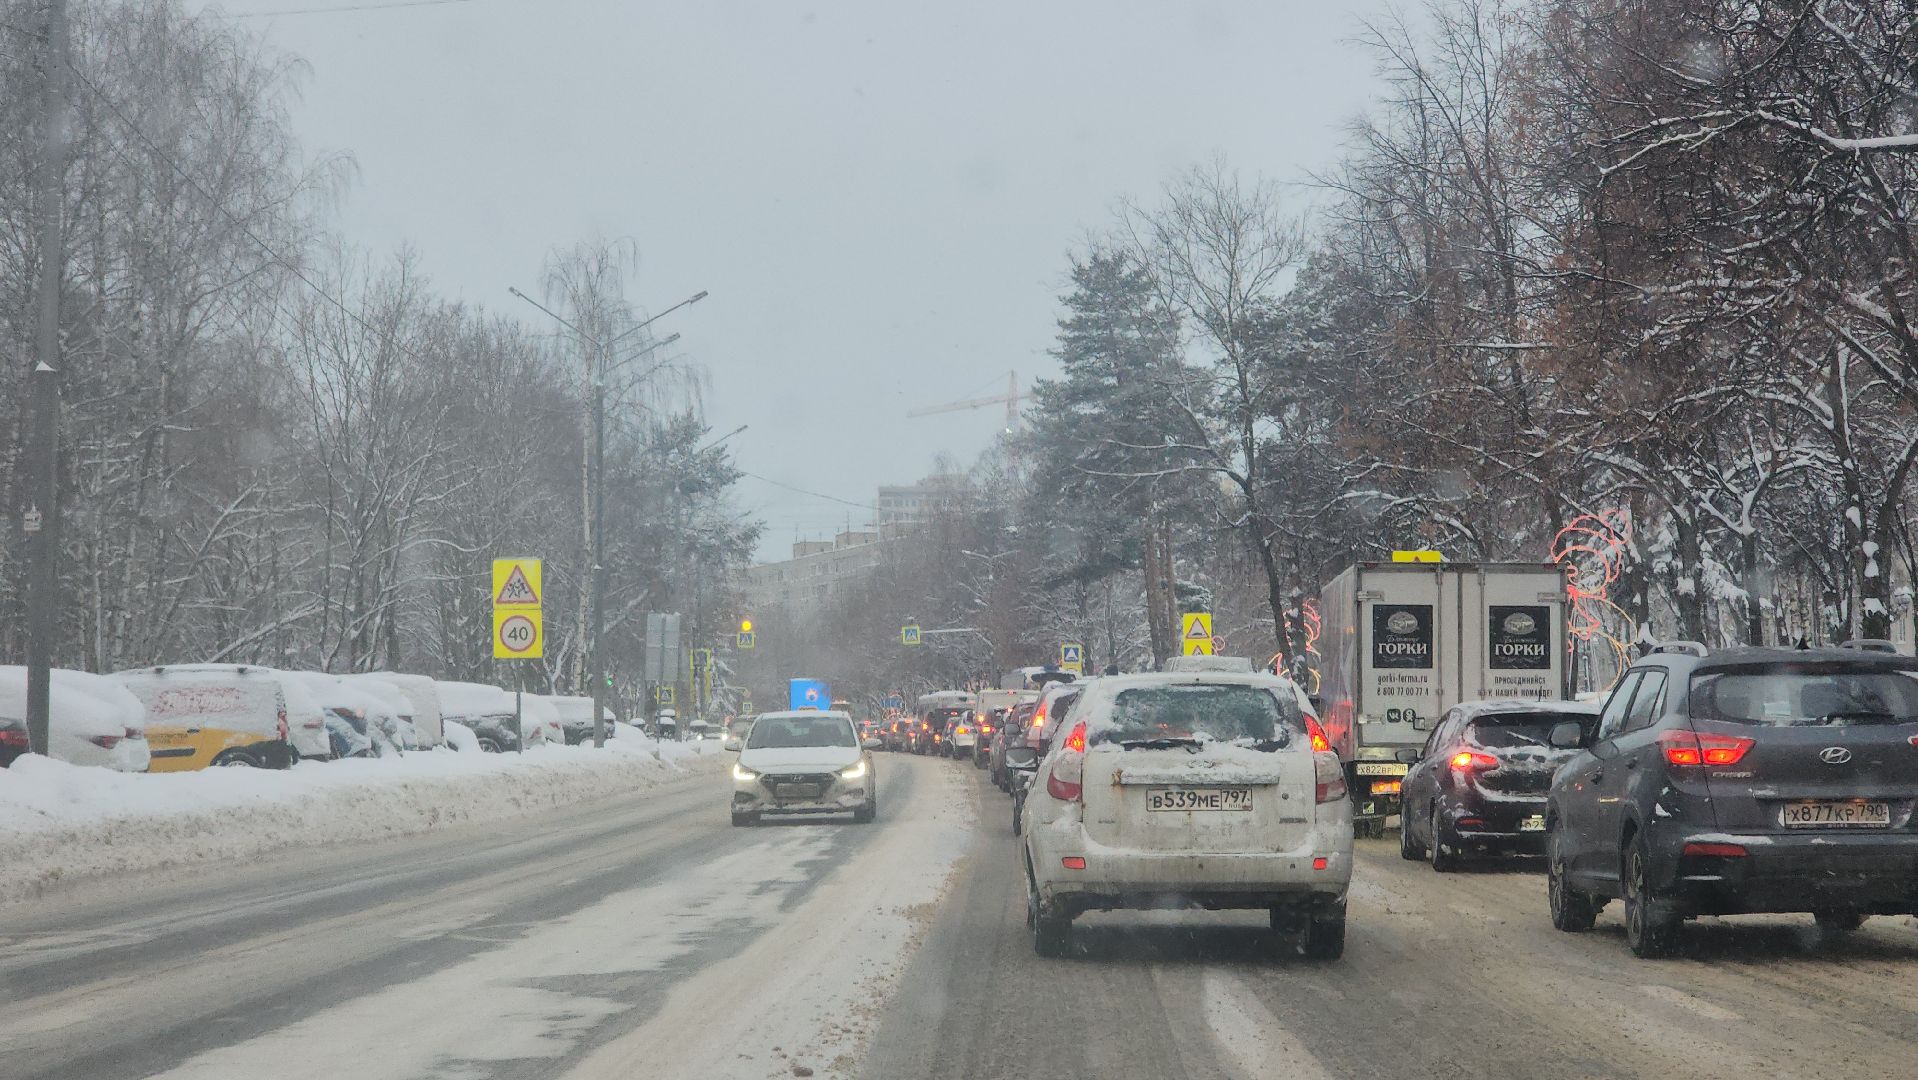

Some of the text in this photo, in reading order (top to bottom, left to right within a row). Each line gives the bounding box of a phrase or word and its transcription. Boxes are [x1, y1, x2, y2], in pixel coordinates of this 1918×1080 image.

[508, 626, 528, 642] 40
[1378, 642, 1427, 655] ГОРКИ
[1495, 643, 1545, 656] ГОРКИ
[1377, 672, 1428, 686] gorki-ferma.ru
